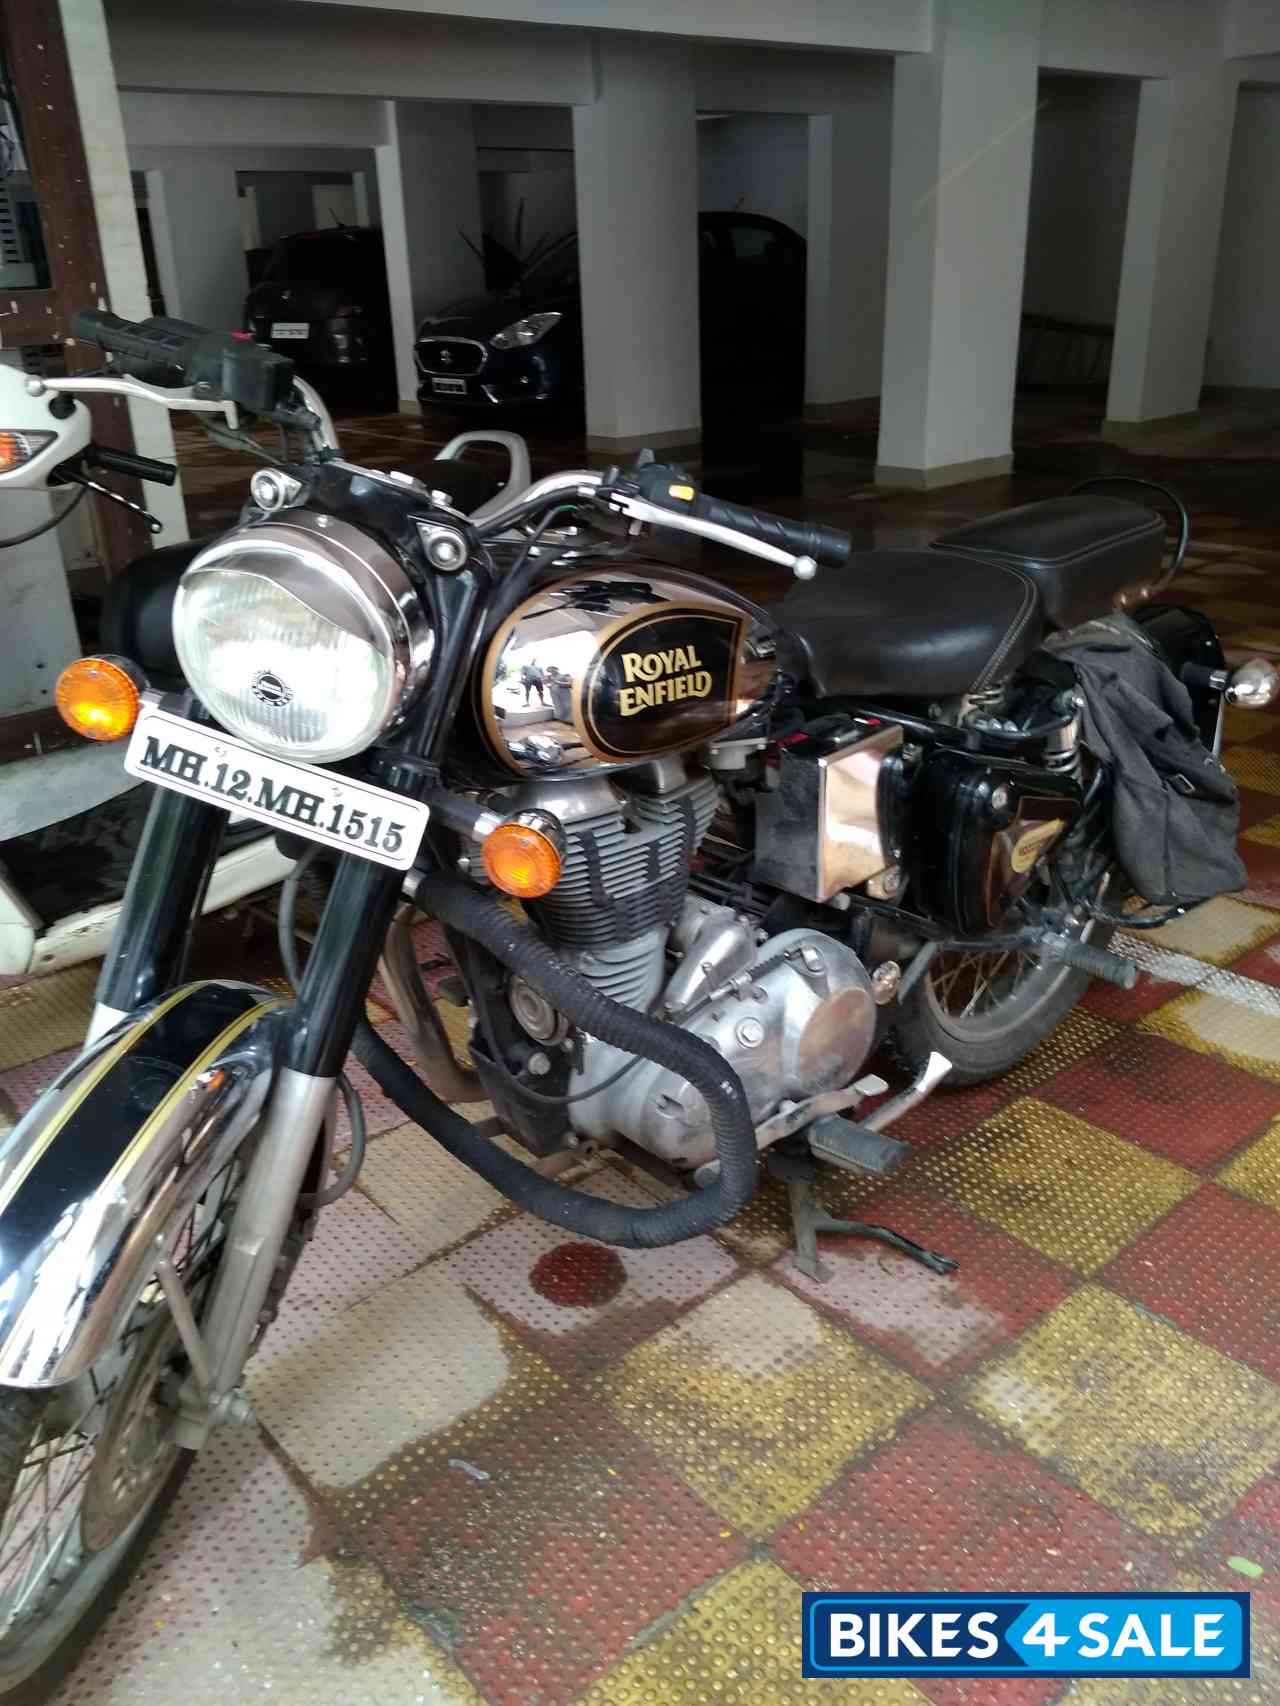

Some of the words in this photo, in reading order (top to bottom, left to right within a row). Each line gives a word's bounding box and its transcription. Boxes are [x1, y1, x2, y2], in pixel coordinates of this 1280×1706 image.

[621, 645, 702, 683] ROYAL
[619, 670, 713, 717] ENFIELD
[140, 736, 406, 853] MH.12.MH.1515
